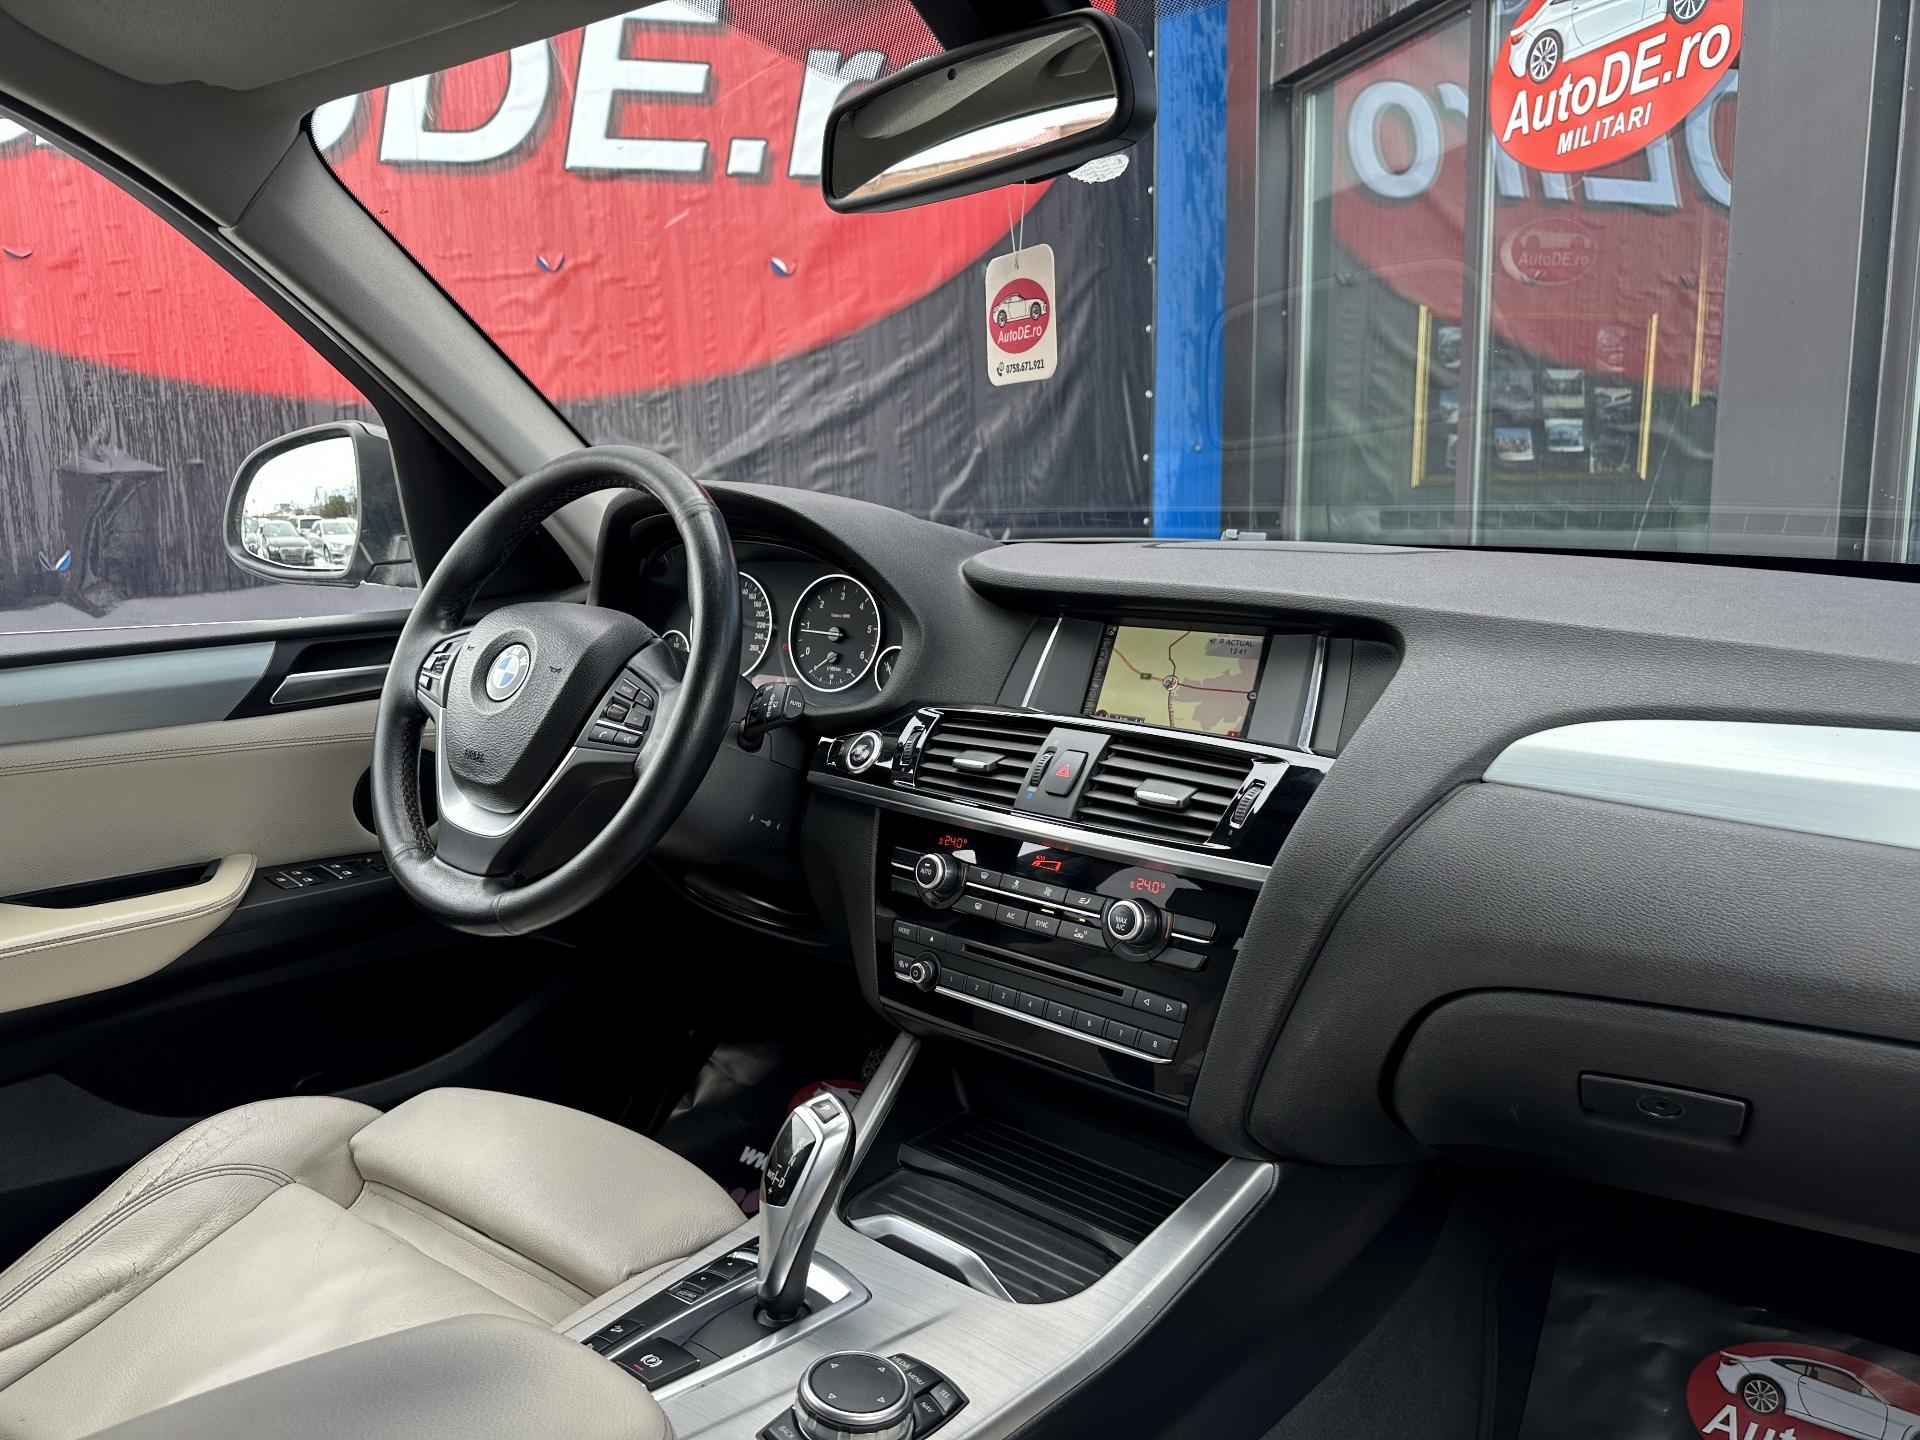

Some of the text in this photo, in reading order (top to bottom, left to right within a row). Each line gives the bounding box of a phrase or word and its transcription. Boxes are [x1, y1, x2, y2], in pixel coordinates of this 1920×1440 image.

[1502, 22, 1731, 143] AutoDE.ro
[1556, 103, 1652, 155] MILITARI
[997, 325, 1043, 345] AutoDE.ro
[755, 610, 766, 618] 200
[1226, 639, 1254, 648] ACTUAL
[790, 700, 802, 708] AUTO
[1035, 920, 1049, 929] SYNC
[1115, 916, 1128, 925] MAX
[1115, 923, 1126, 931] A/C
[778, 1177, 786, 1189] D
[907, 1371, 925, 1386] MENU
[940, 1389, 951, 1399] TEL
[920, 1401, 935, 1413] NAV
[777, 1425, 793, 1439] BACK
